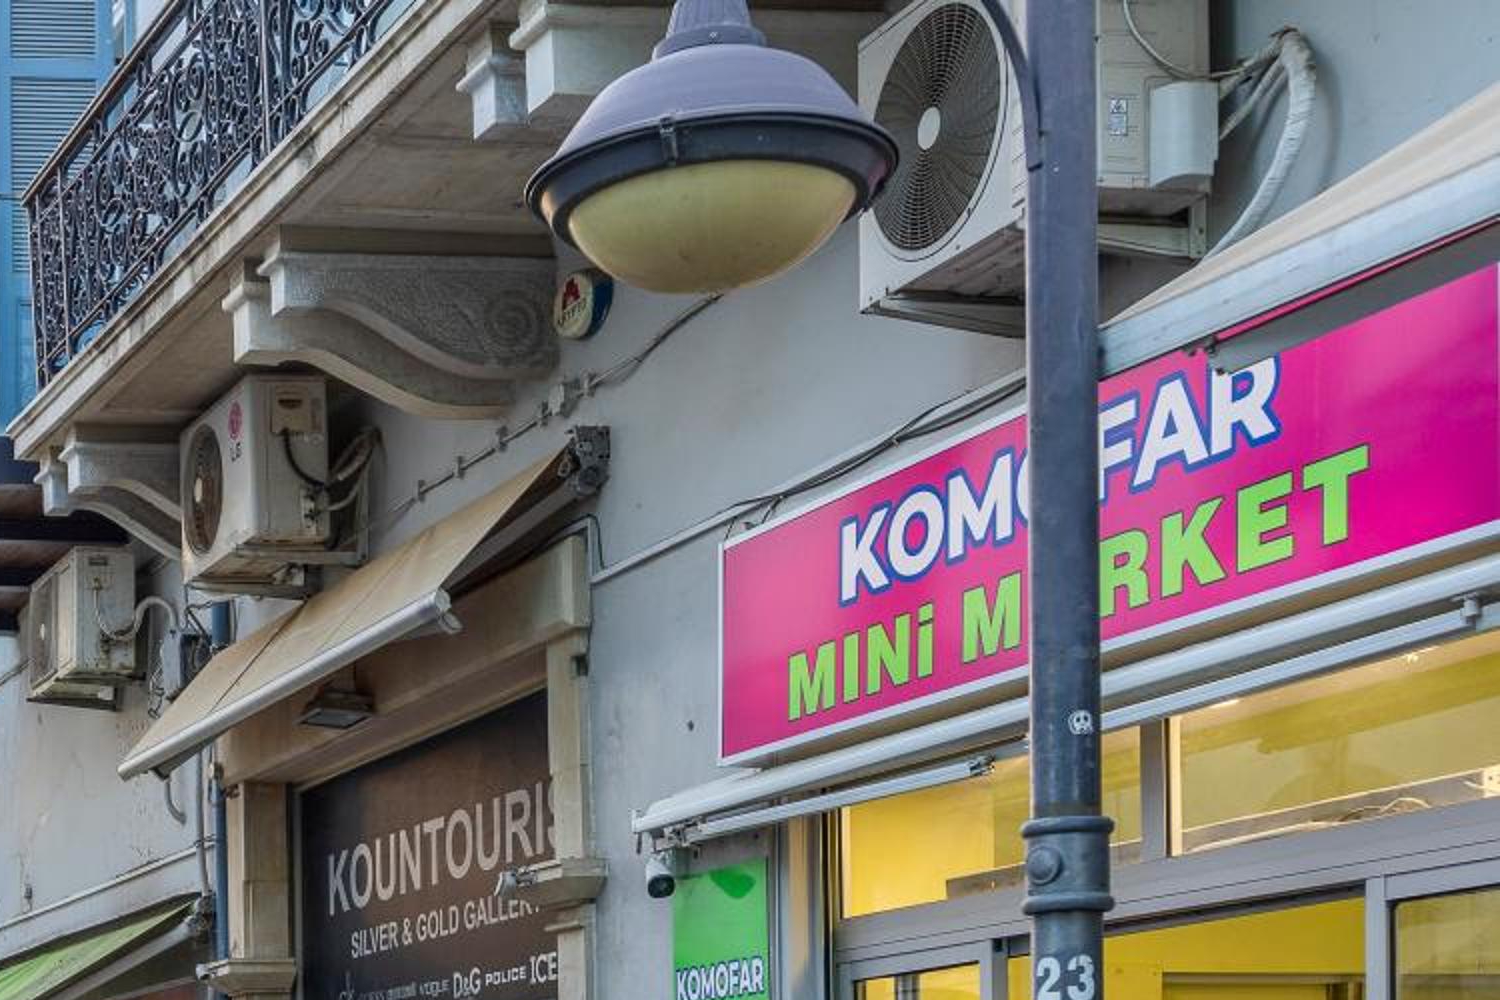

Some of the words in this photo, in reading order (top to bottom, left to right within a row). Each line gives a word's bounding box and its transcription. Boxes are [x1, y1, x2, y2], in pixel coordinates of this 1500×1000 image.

[840, 354, 1280, 606] KOMFAR
[961, 445, 1370, 664] MRKET
[350, 920, 399, 959] SILVER
[401, 917, 413, 946] &
[415, 904, 460, 942] GOLD
[463, 893, 540, 930] GALLER
[452, 967, 482, 999] D&G
[485, 965, 527, 987] POLICE
